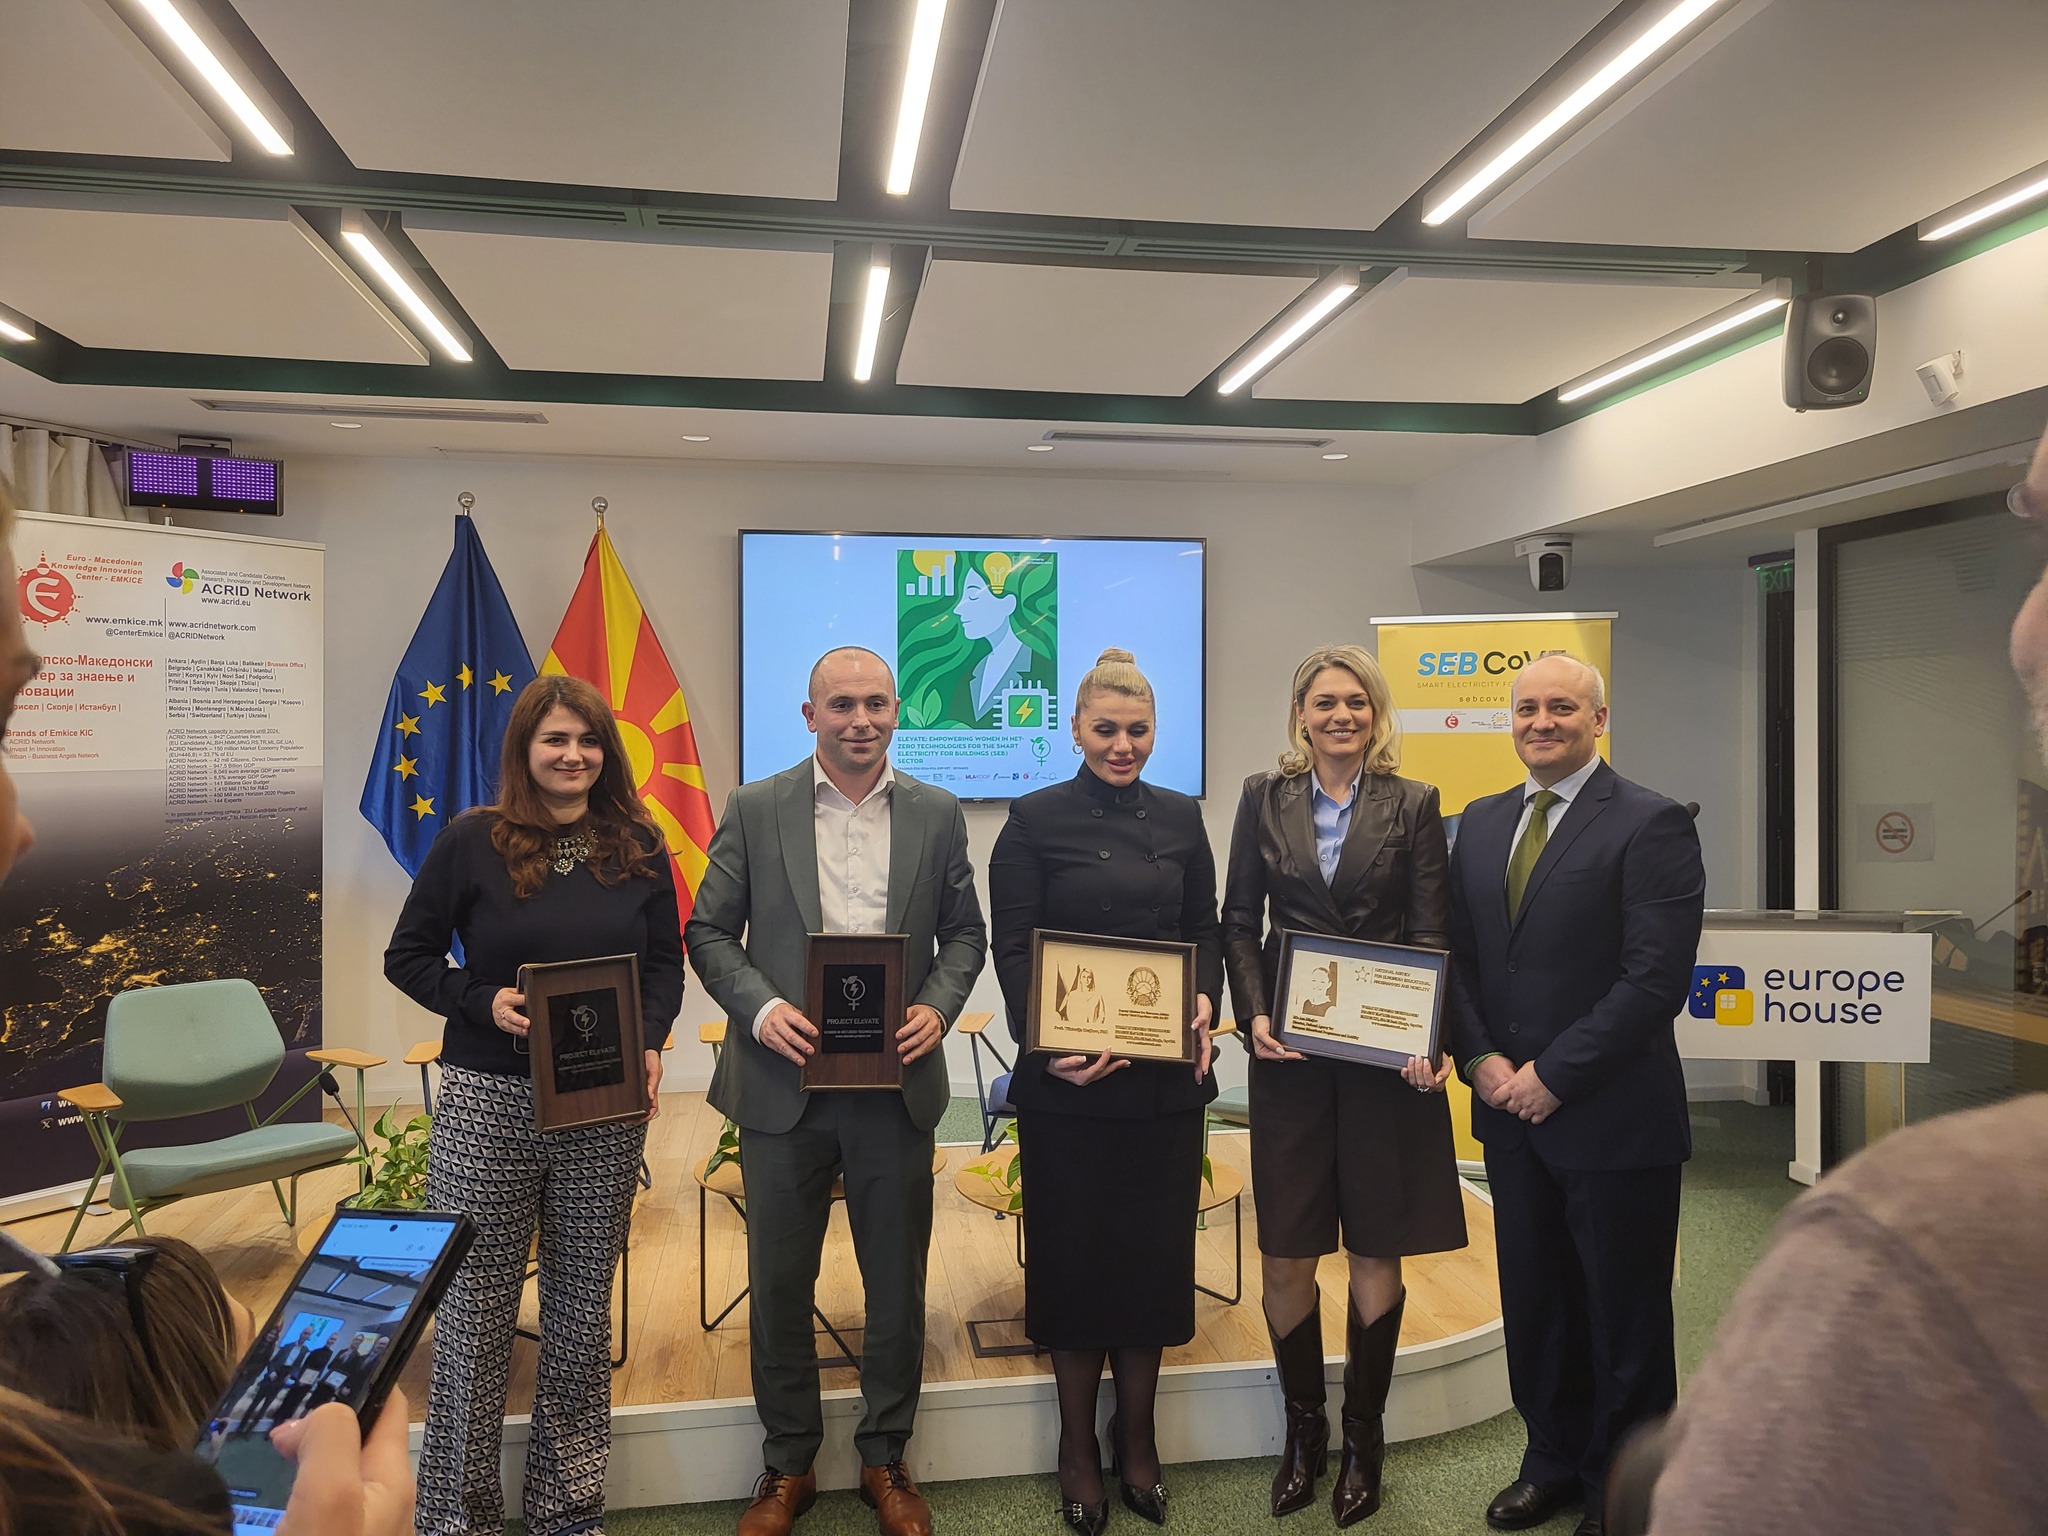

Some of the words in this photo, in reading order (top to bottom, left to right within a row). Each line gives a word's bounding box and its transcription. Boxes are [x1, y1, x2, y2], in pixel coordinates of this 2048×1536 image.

[66, 554, 86, 562] Euro
[94, 556, 143, 566] Macedonian
[51, 562, 97, 572] Knowledge
[100, 566, 143, 575] Innovation
[76, 573, 103, 581] Center
[111, 575, 143, 584] EMKICE
[201, 575, 225, 583] Research,
[262, 580, 292, 588] Development
[1759, 569, 1793, 592] EXIT
[201, 583, 250, 597] ACRID
[254, 587, 311, 601] Network
[201, 597, 251, 606] www.acrid.eu
[86, 616, 163, 627] www.emkice.mk
[168, 620, 257, 631] www.acridnetwork.com
[105, 628, 163, 637] @CenterEmkice
[168, 631, 225, 640] @ACRIDNetwork
[1417, 652, 1479, 676] SEB
[60, 673, 73, 681] за
[77, 673, 123, 682] знаење
[128, 673, 135, 682] и
[17, 687, 74, 698] новации
[46, 703, 73, 713] Скопје
[80, 703, 117, 712] Истанбул
[6, 729, 36, 737] Brands
[40, 729, 48, 737] of
[50, 729, 77, 737] Emkice
[80, 729, 93, 737] KIC
[1764, 968, 1905, 1000] europe
[1765, 993, 1882, 1024] house
